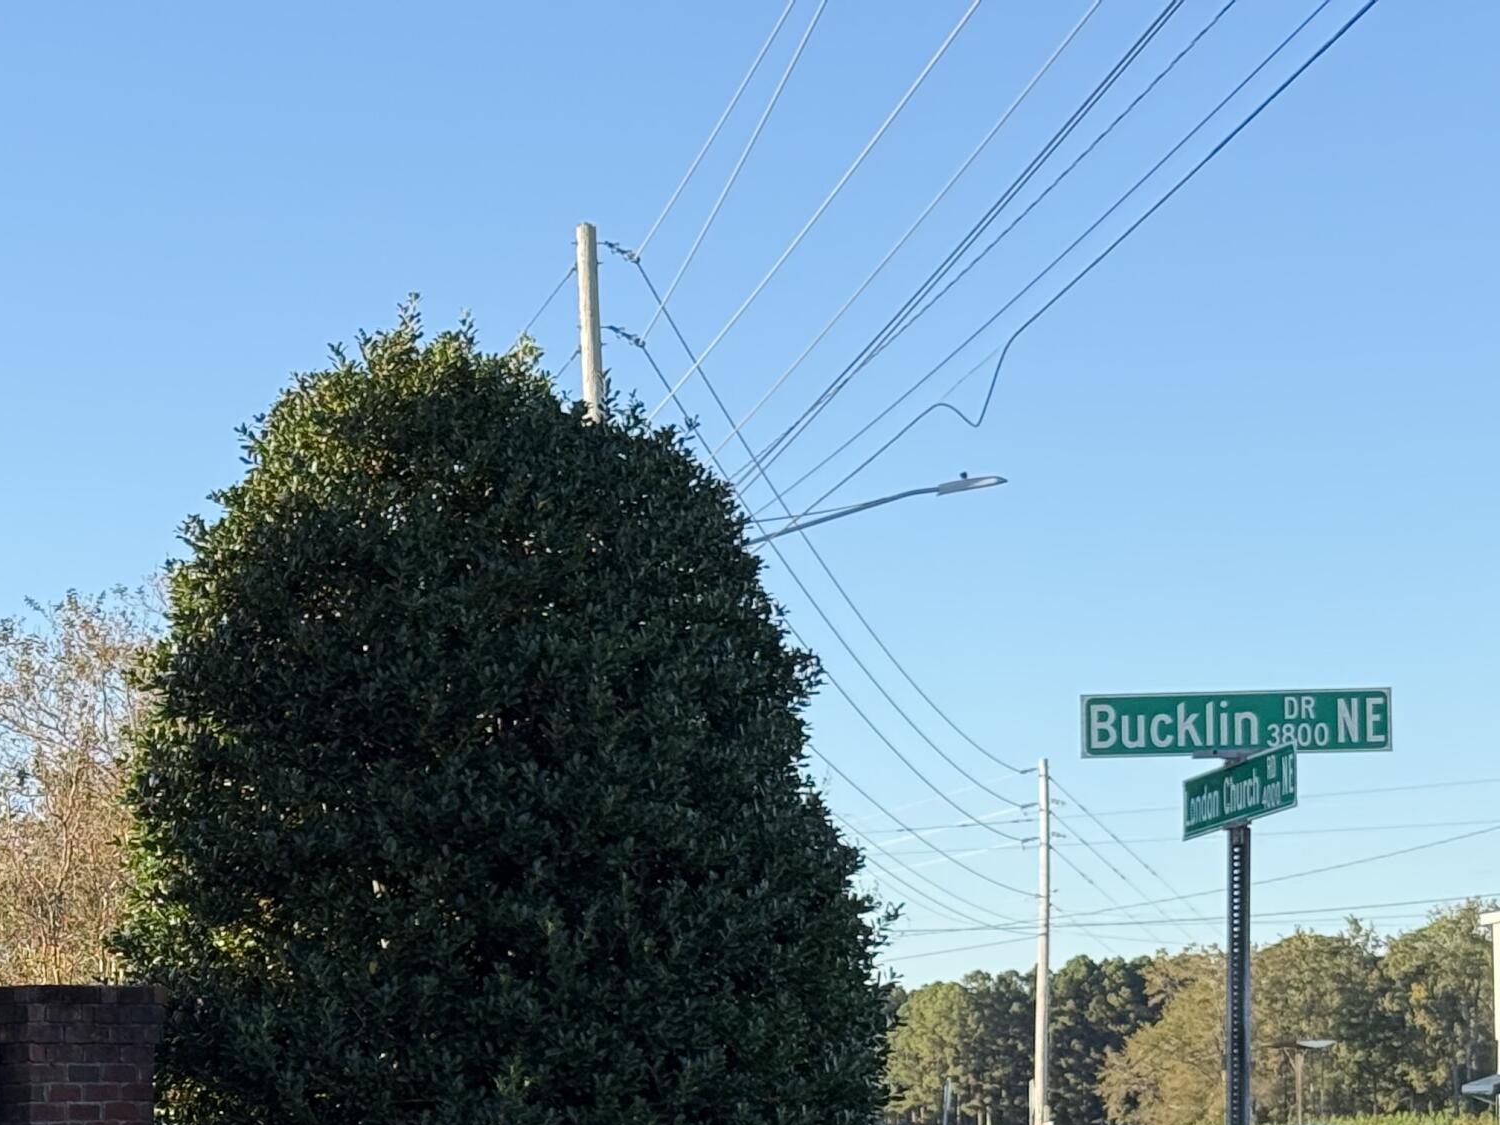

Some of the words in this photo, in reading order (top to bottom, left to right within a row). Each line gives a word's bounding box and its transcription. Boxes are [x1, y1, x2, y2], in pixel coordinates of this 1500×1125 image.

[1089, 702, 1258, 749] Bucklin
[1284, 696, 1315, 719] DR
[1337, 697, 1385, 743] NE
[1267, 722, 1329, 747] 3800
[1185, 785, 1219, 826] London
[1223, 768, 1260, 815] Church
[1282, 754, 1294, 794] NE
